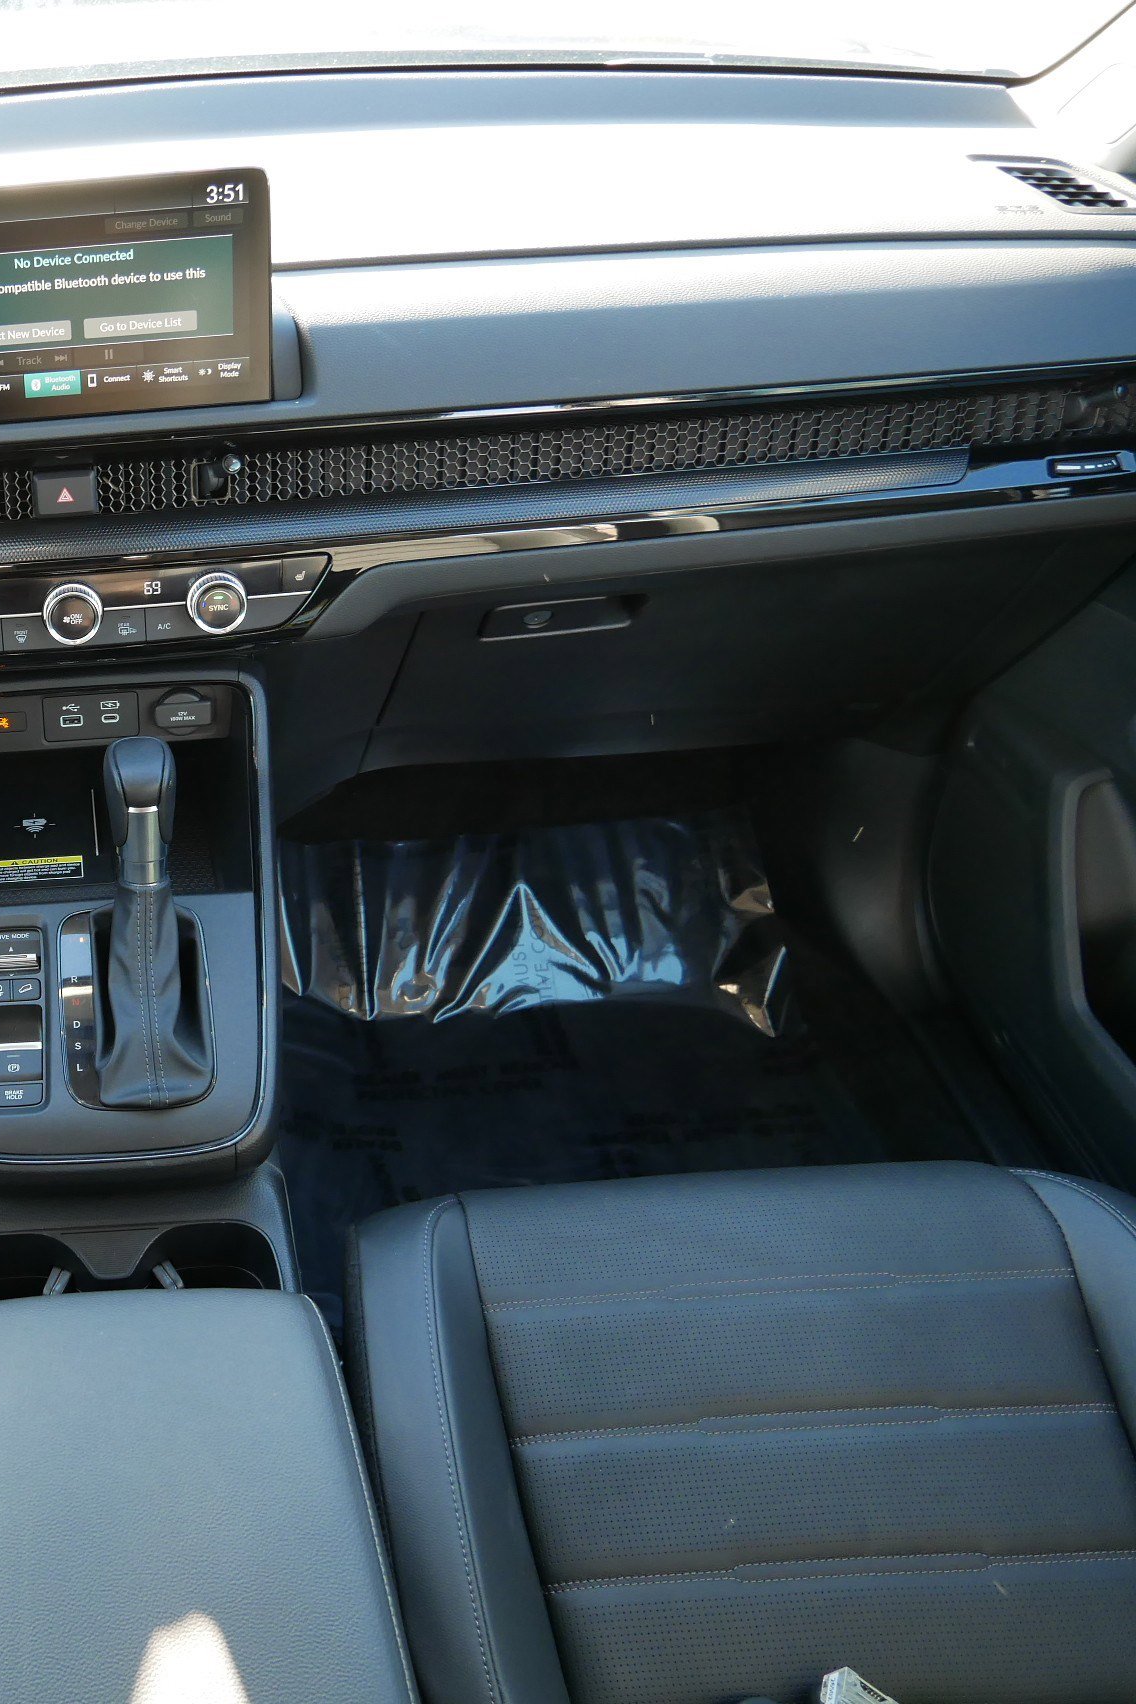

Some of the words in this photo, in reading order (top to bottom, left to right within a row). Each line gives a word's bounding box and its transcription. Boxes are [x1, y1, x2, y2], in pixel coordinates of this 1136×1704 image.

[205, 184, 244, 204] 3:51
[205, 213, 232, 223] Sound
[115, 221, 147, 232] Change
[149, 217, 179, 227] Device
[14, 257, 31, 269] No
[33, 253, 72, 268] Device
[73, 249, 134, 265] Connected
[54, 275, 109, 290] Bluetooth
[111, 271, 147, 285] device
[148, 272, 161, 282] to
[163, 271, 183, 281] use
[185, 267, 206, 279] this
[100, 322, 114, 333] Go
[116, 322, 127, 331] to
[129, 319, 163, 330] Device
[165, 317, 182, 327] List
[7, 329, 30, 341] New
[32, 326, 65, 340] Device
[17, 356, 42, 366] Track
[163, 366, 183, 375] Smart
[218, 361, 242, 372] Display
[103, 374, 131, 383] Connect
[158, 373, 189, 383] Shortcuts
[220, 370, 240, 378] Mode
[45, 374, 76, 384] Bluetooth
[51, 382, 71, 391] Audio
[143, 581, 162, 595] 69
[208, 603, 229, 612] SYNC
[157, 622, 172, 630] A/C
[11, 932, 31, 940] MODE
[71, 976, 79, 984] R
[72, 998, 81, 1006] N
[73, 1020, 81, 1029] D
[74, 1042, 82, 1051] S
[76, 1064, 84, 1072] L
